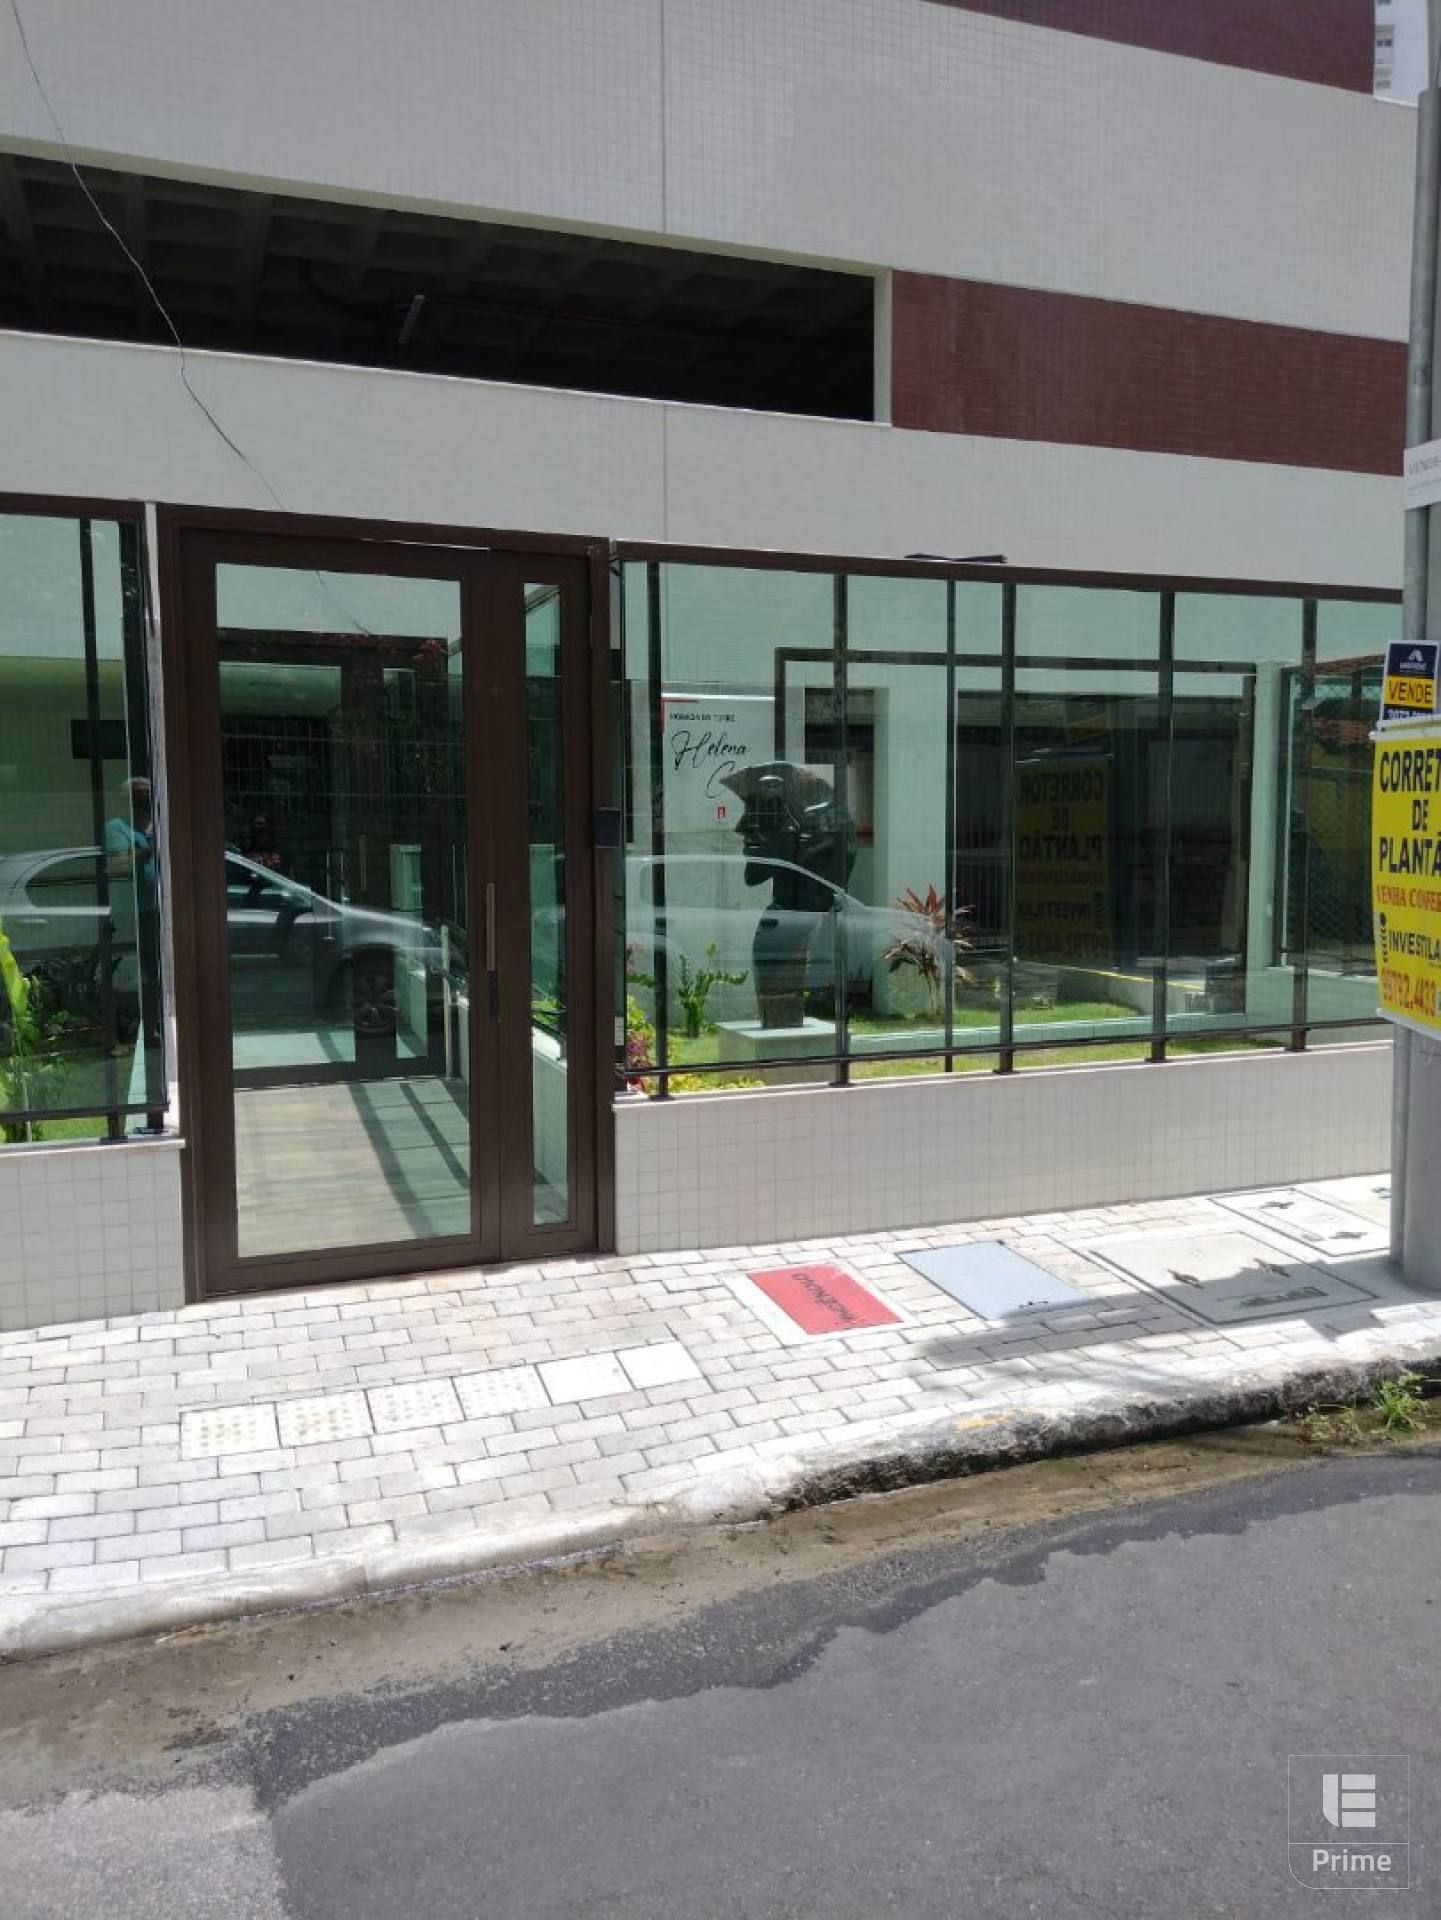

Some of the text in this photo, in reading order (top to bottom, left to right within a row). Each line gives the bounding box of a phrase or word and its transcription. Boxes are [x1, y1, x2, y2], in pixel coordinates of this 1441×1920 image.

[1389, 680, 1432, 704] VENDE
[670, 730, 746, 771] Helena
[1412, 799, 1429, 831] DE
[1376, 884, 1407, 907] VENHA
